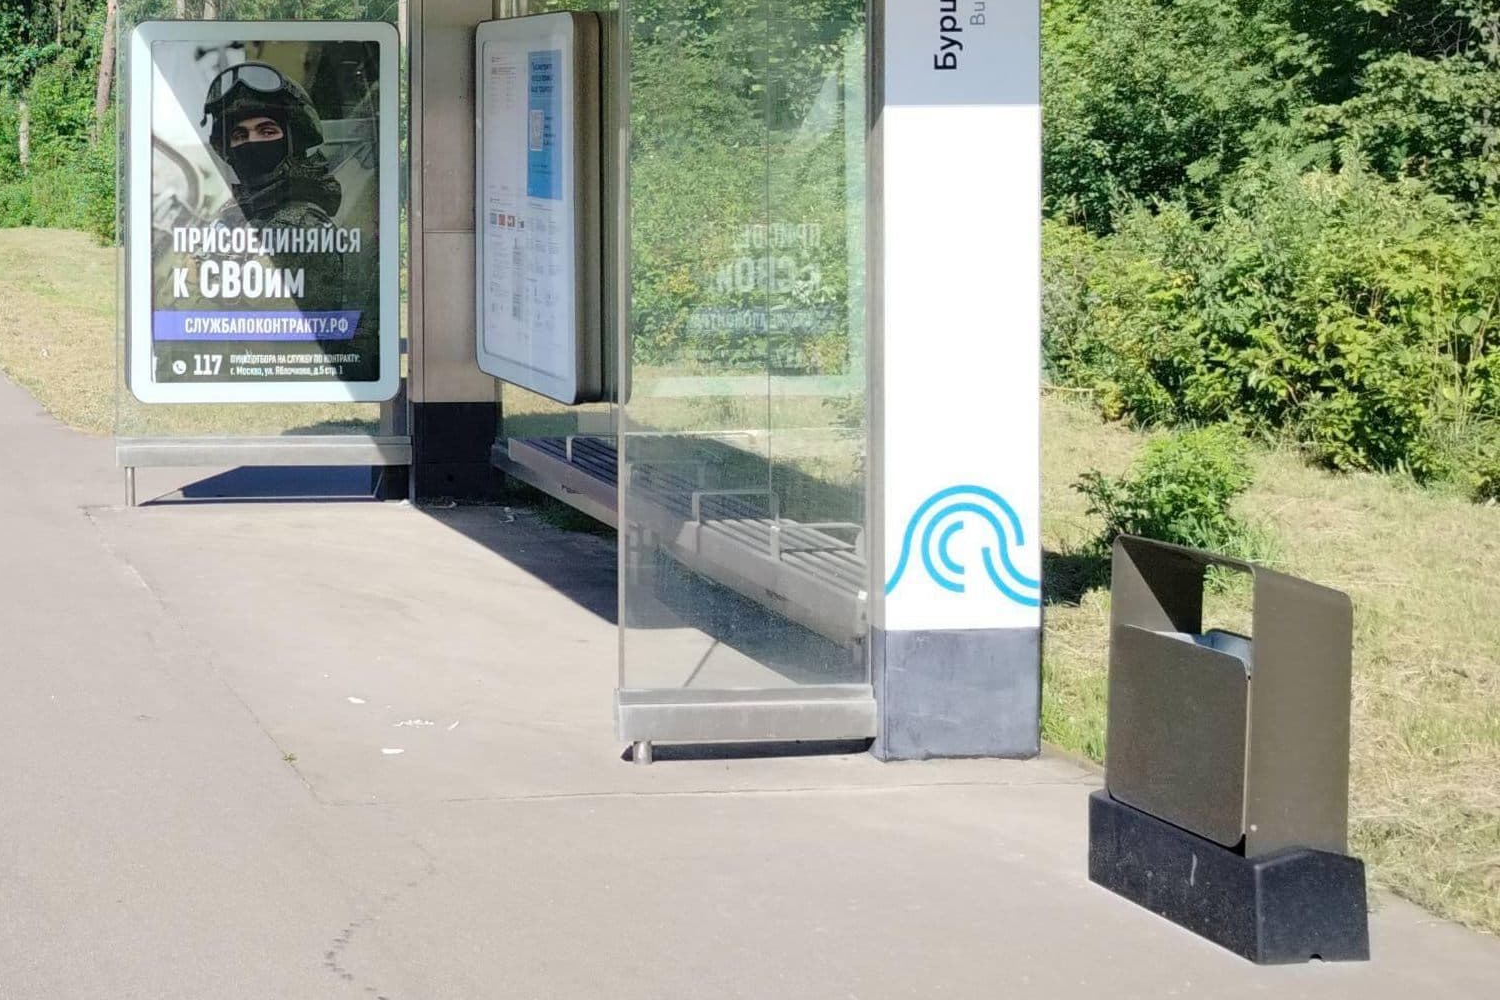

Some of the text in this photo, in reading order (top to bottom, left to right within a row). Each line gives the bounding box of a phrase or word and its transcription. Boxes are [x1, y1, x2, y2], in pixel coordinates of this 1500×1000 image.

[173, 223, 361, 256] ПРИСОЕДИНЯЙСЯ
[184, 317, 350, 335] СЛУЖБАПОКОНТРАКТУ.РФ
[193, 354, 223, 376] 117
